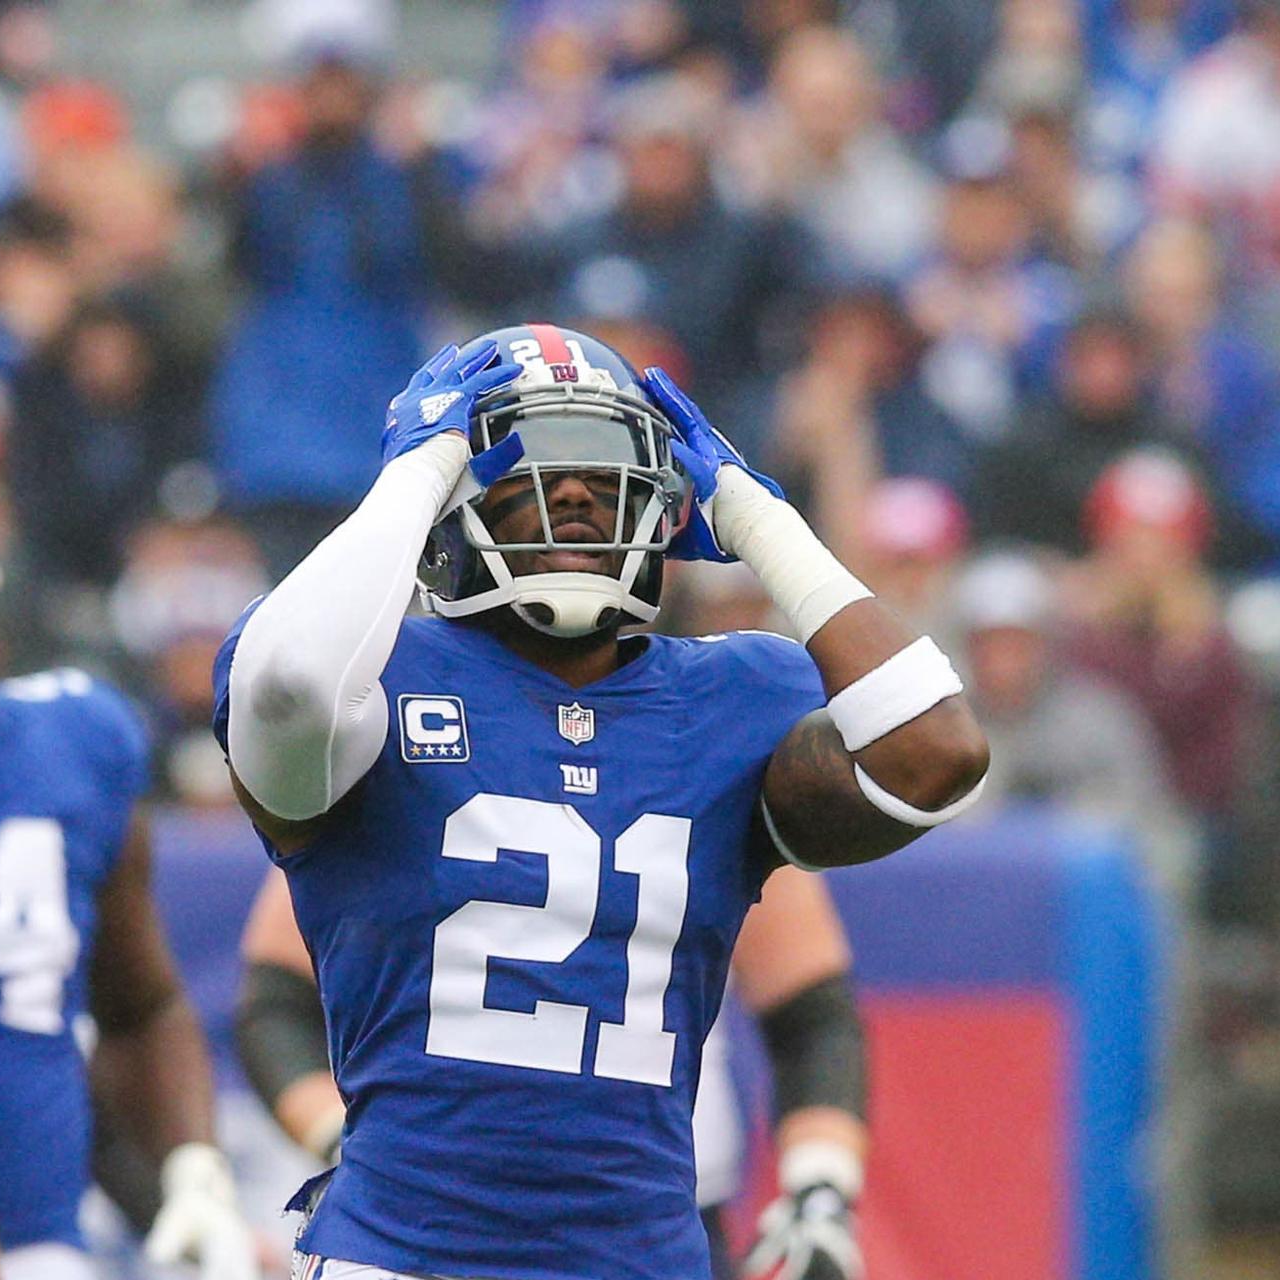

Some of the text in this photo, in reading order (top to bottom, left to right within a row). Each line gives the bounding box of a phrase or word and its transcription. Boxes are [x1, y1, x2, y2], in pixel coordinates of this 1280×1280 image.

[508, 338, 589, 370] 21
[404, 700, 461, 744] C
[564, 721, 588, 736] NFL
[425, 792, 692, 1087] 21
